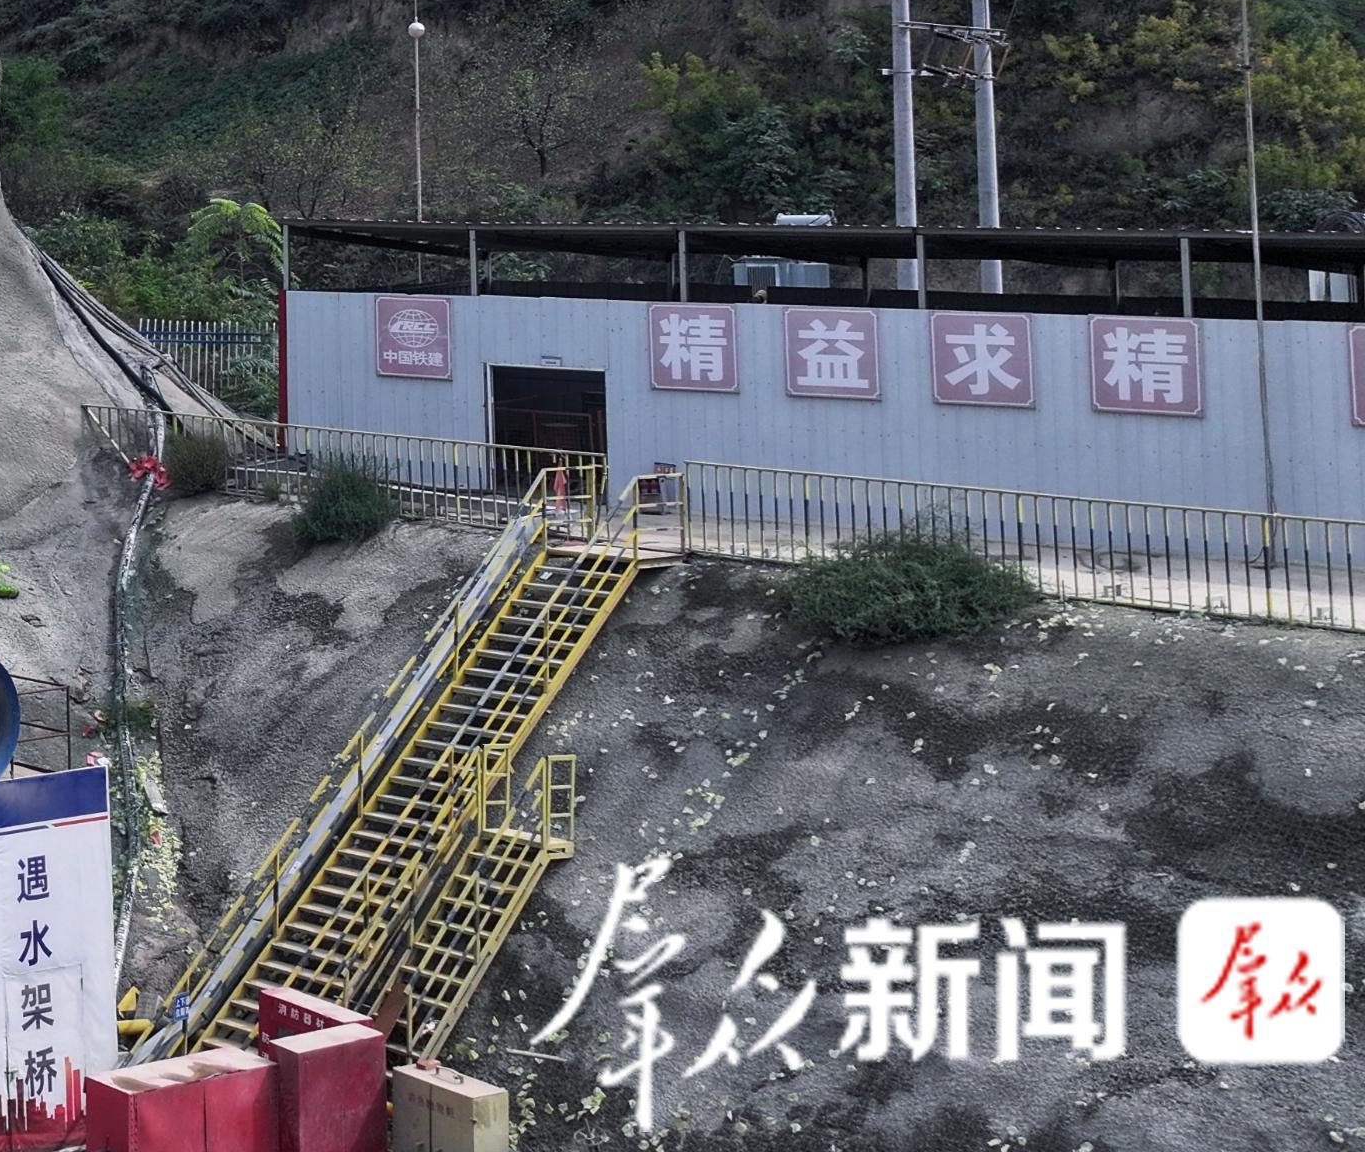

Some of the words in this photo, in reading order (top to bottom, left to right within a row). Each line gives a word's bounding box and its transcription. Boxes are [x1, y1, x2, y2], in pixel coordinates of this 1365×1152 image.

[383, 349, 444, 367] 中国铁建
[658, 313, 1188, 404] 精益求精
[17, 855, 58, 1097] 遇水架桥
[276, 1003, 325, 1030] 消防器材
